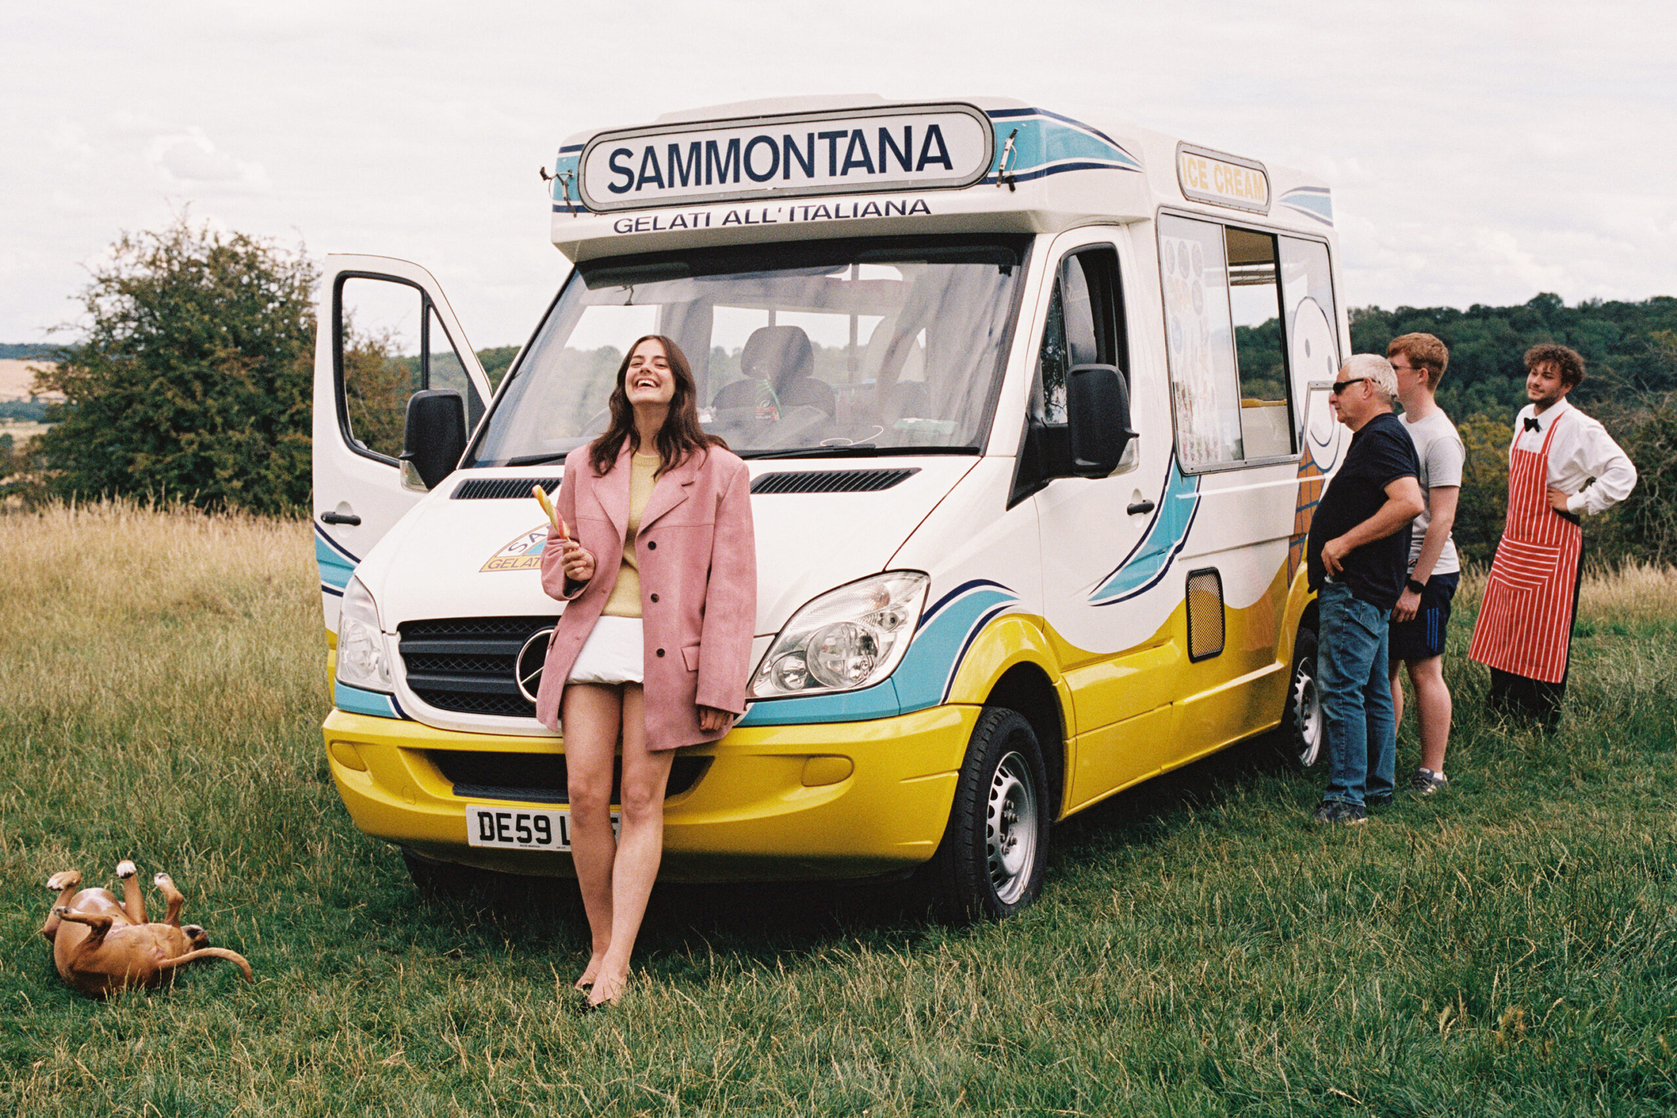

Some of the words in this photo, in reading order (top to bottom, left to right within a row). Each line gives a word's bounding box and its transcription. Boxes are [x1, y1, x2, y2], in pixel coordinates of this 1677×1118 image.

[607, 124, 953, 194] SAMMONTANA
[1182, 155, 1209, 190] ICE
[1213, 165, 1265, 202] CREAM
[613, 214, 711, 234] GELATI
[508, 525, 549, 553] SA
[488, 557, 541, 569] GELAT
[477, 811, 552, 845] DE59
